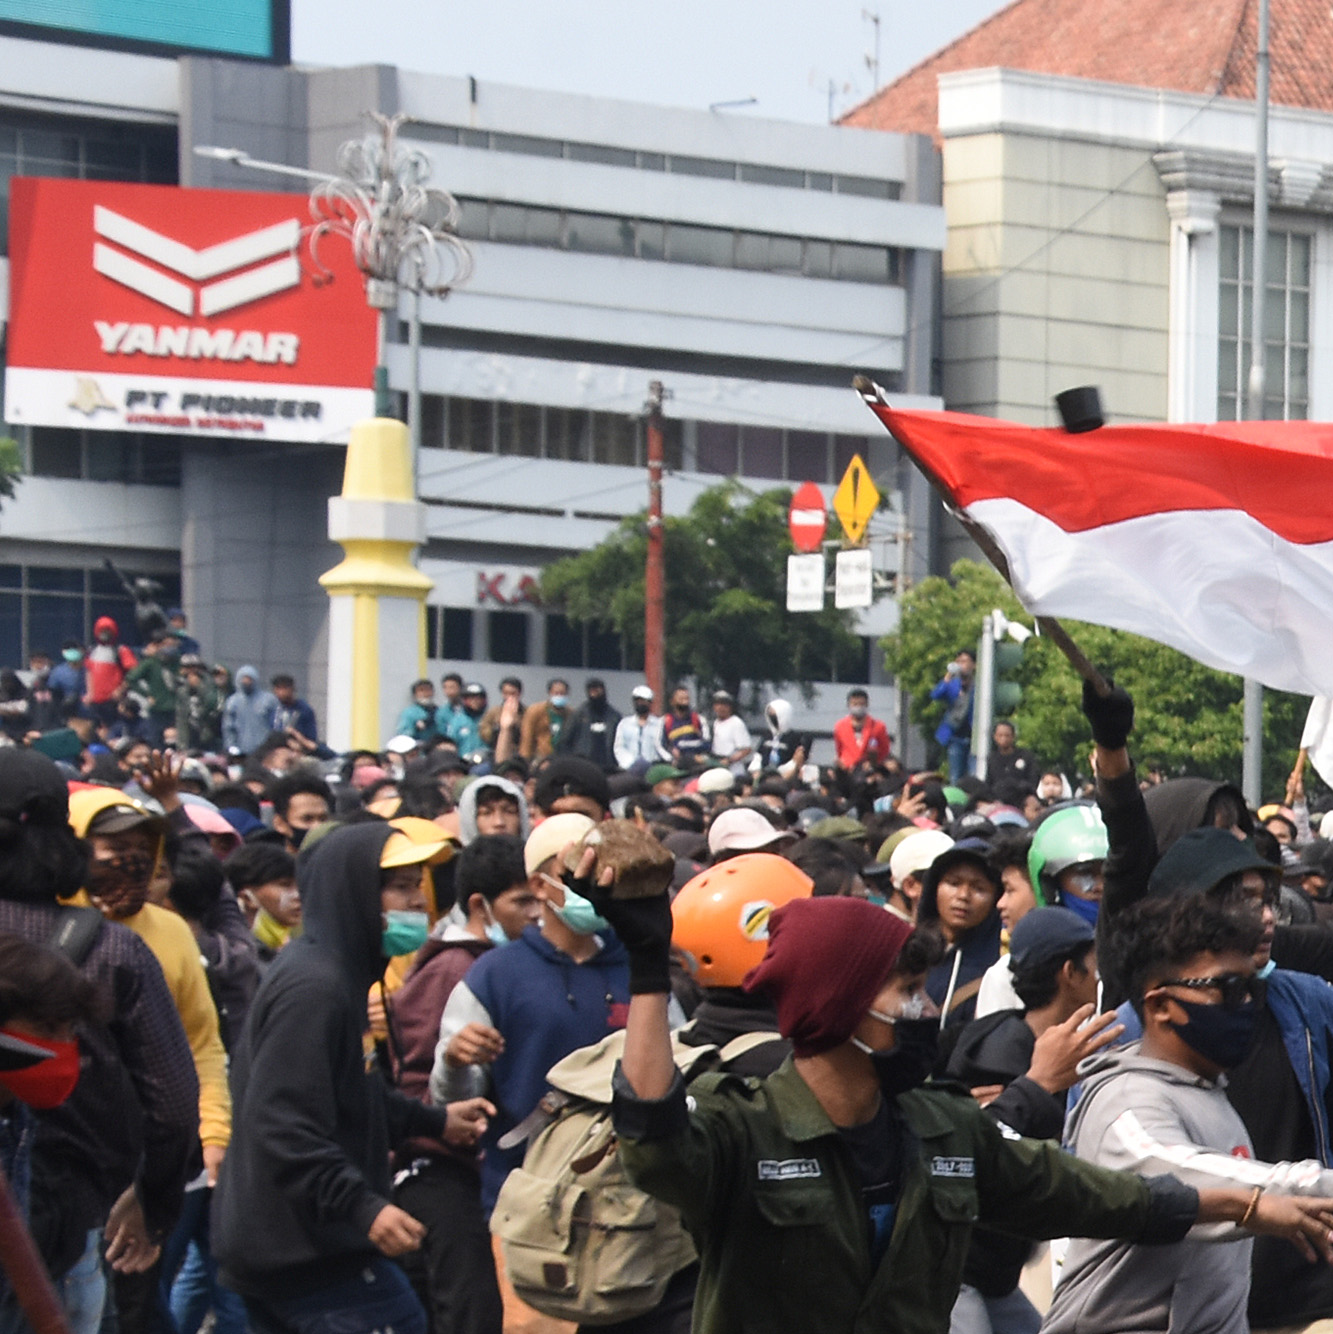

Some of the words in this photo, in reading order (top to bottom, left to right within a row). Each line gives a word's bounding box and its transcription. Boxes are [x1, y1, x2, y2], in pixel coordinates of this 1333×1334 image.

[94, 320, 298, 365] YANMAR
[126, 390, 168, 409] PT
[180, 393, 322, 419] PIONEER
